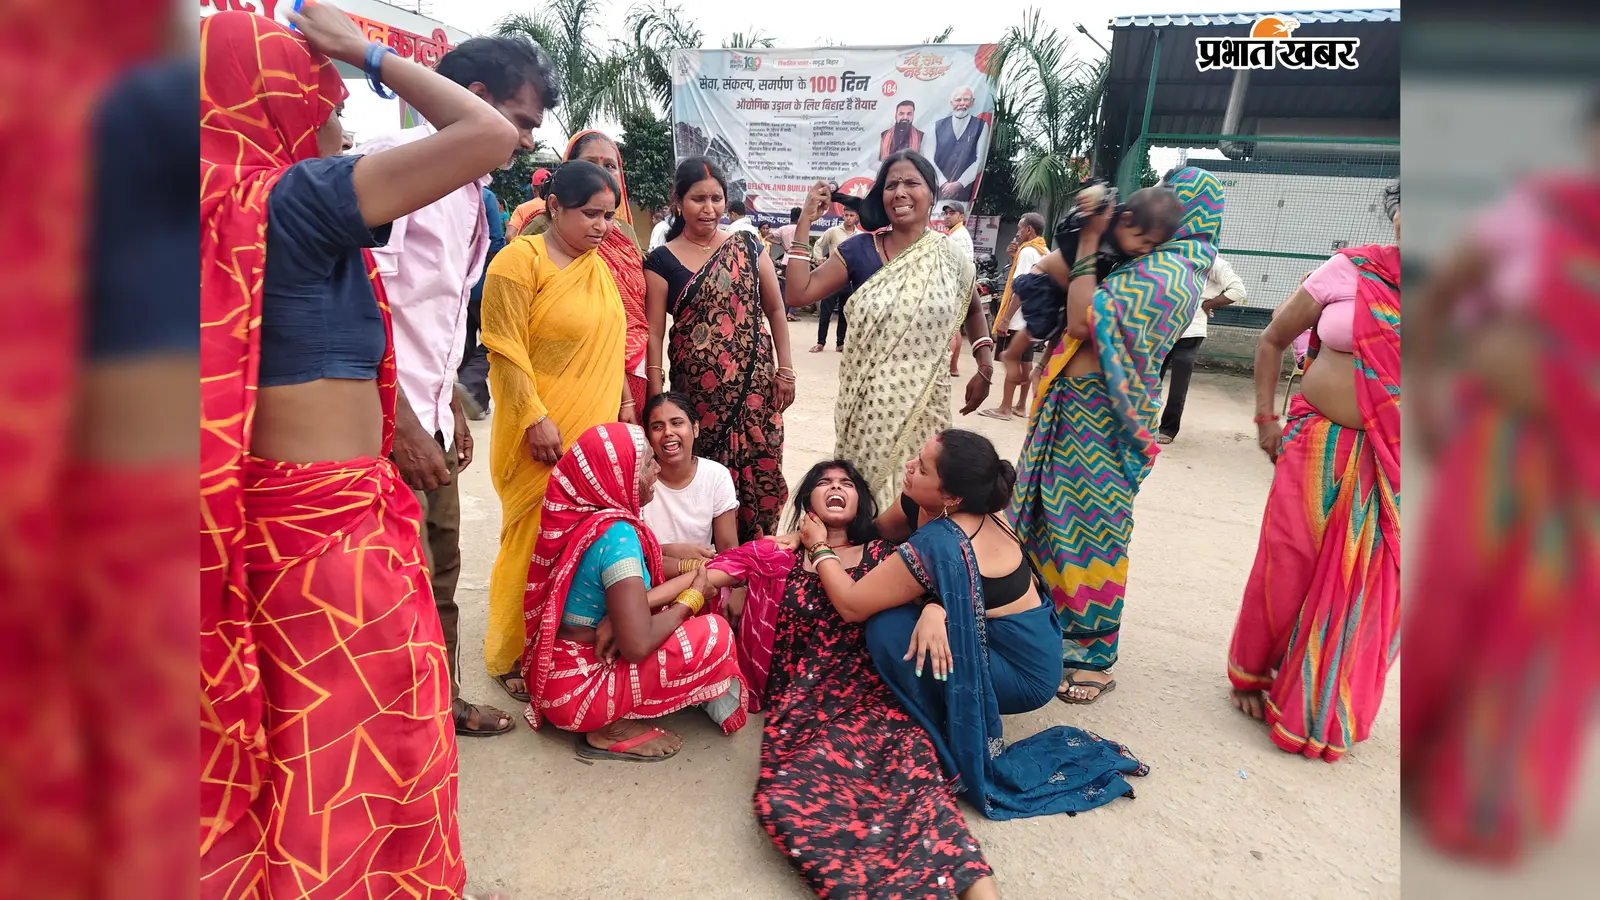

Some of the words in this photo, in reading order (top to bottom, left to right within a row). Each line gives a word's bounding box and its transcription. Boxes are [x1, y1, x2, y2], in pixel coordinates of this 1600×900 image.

[699, 74, 720, 94] सेवा,
[722, 77, 755, 95] संकल्प,
[758, 76, 794, 91] समर्पण
[797, 76, 807, 90] के
[809, 75, 837, 93] 100
[840, 70, 872, 93] दिन
[882, 83, 897, 94] 184
[735, 98, 770, 111] औद्योगिक
[771, 100, 792, 112] उड़ान
[793, 98, 803, 110] के
[803, 98, 820, 110] लिए
[821, 98, 845, 111] बिहार
[846, 97, 854, 110] है
[854, 97, 878, 111] तैयार
[747, 182, 771, 191] BELIEVE
[772, 183, 786, 191] AND
[787, 184, 806, 192] BUILD
